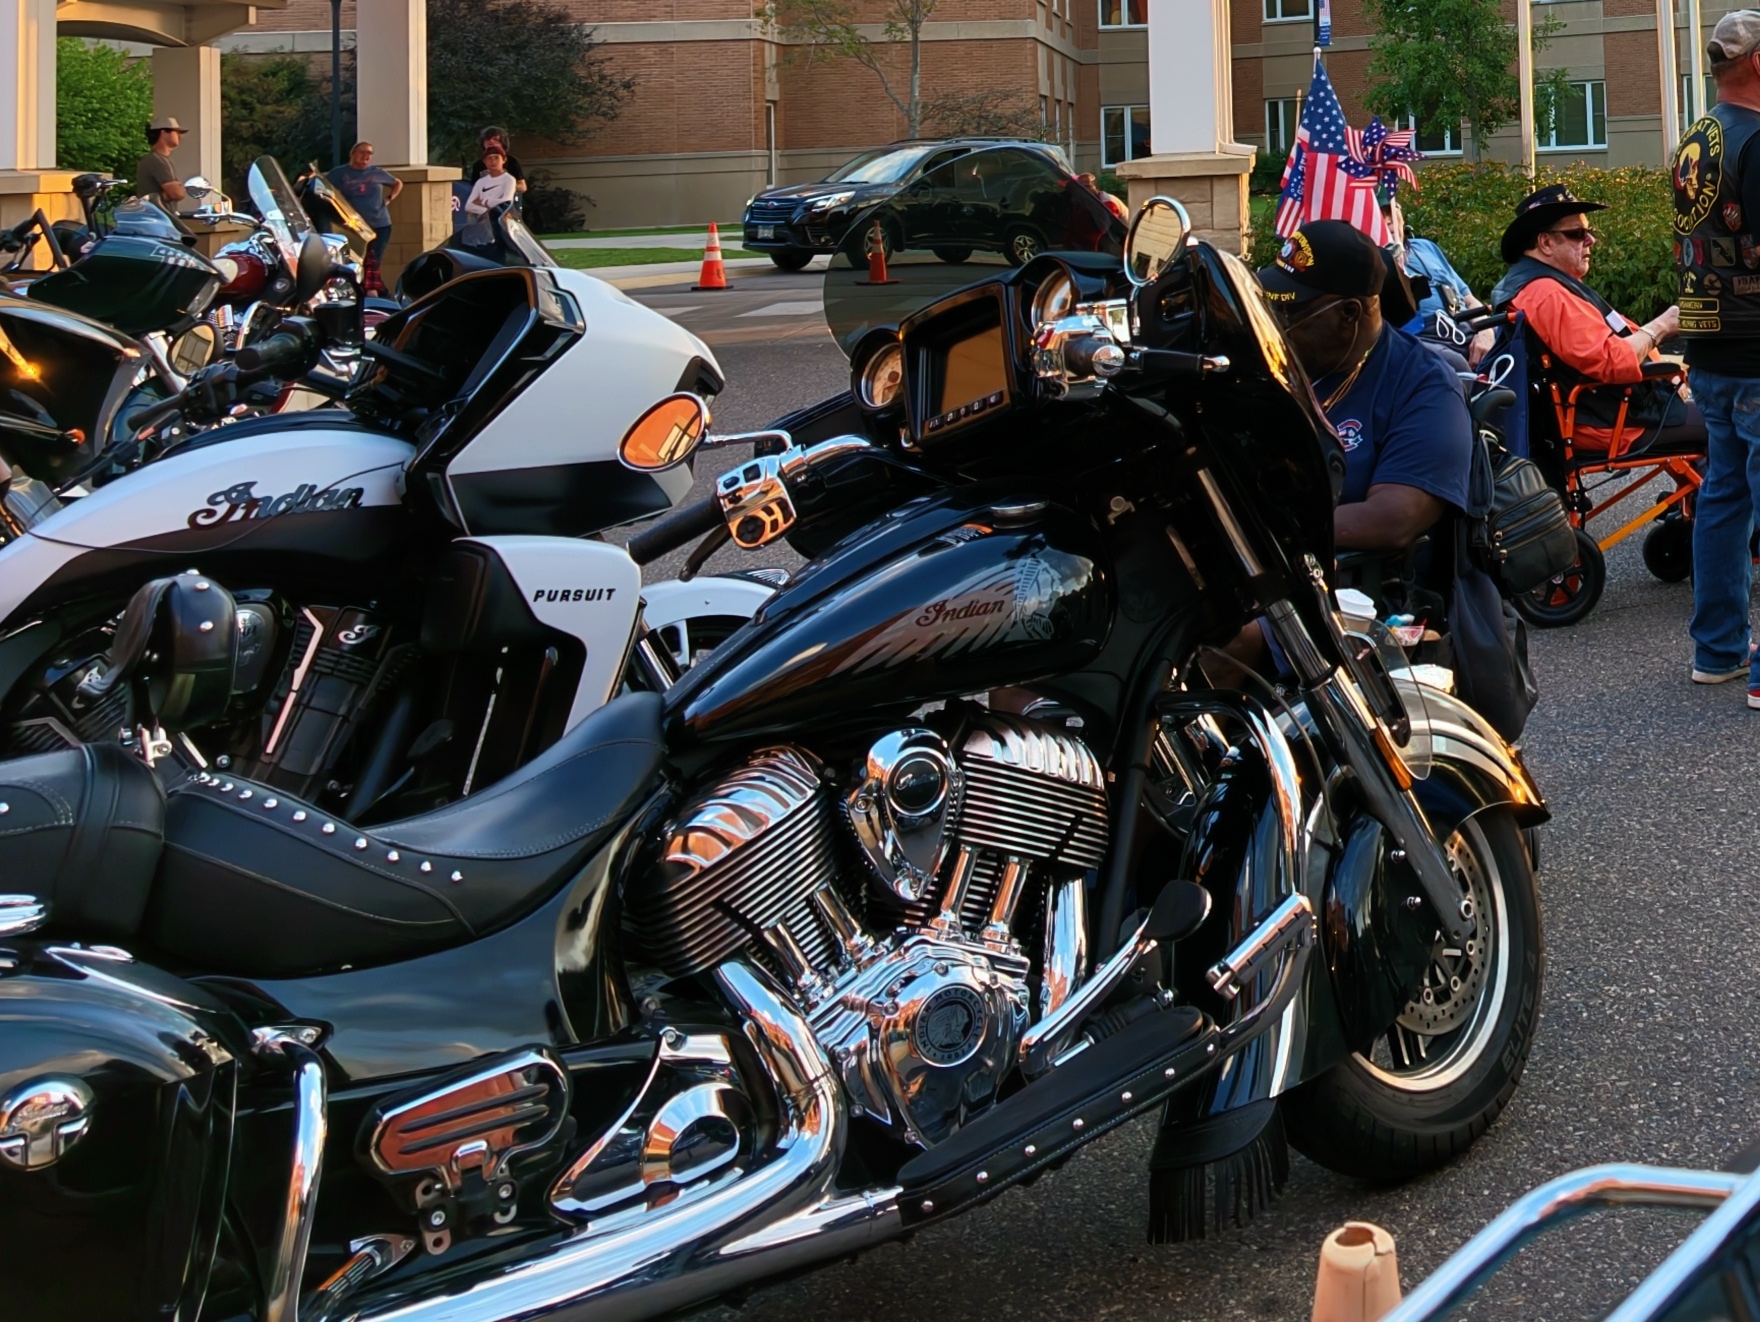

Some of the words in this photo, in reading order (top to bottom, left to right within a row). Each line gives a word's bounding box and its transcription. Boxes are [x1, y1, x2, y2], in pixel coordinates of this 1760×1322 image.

[1706, 123, 1720, 157] VETS
[187, 481, 364, 530] Indian
[533, 588, 617, 603] PURSUIT
[915, 599, 1005, 627] Indian
[935, 989, 983, 1038] MOTORCYCLE
